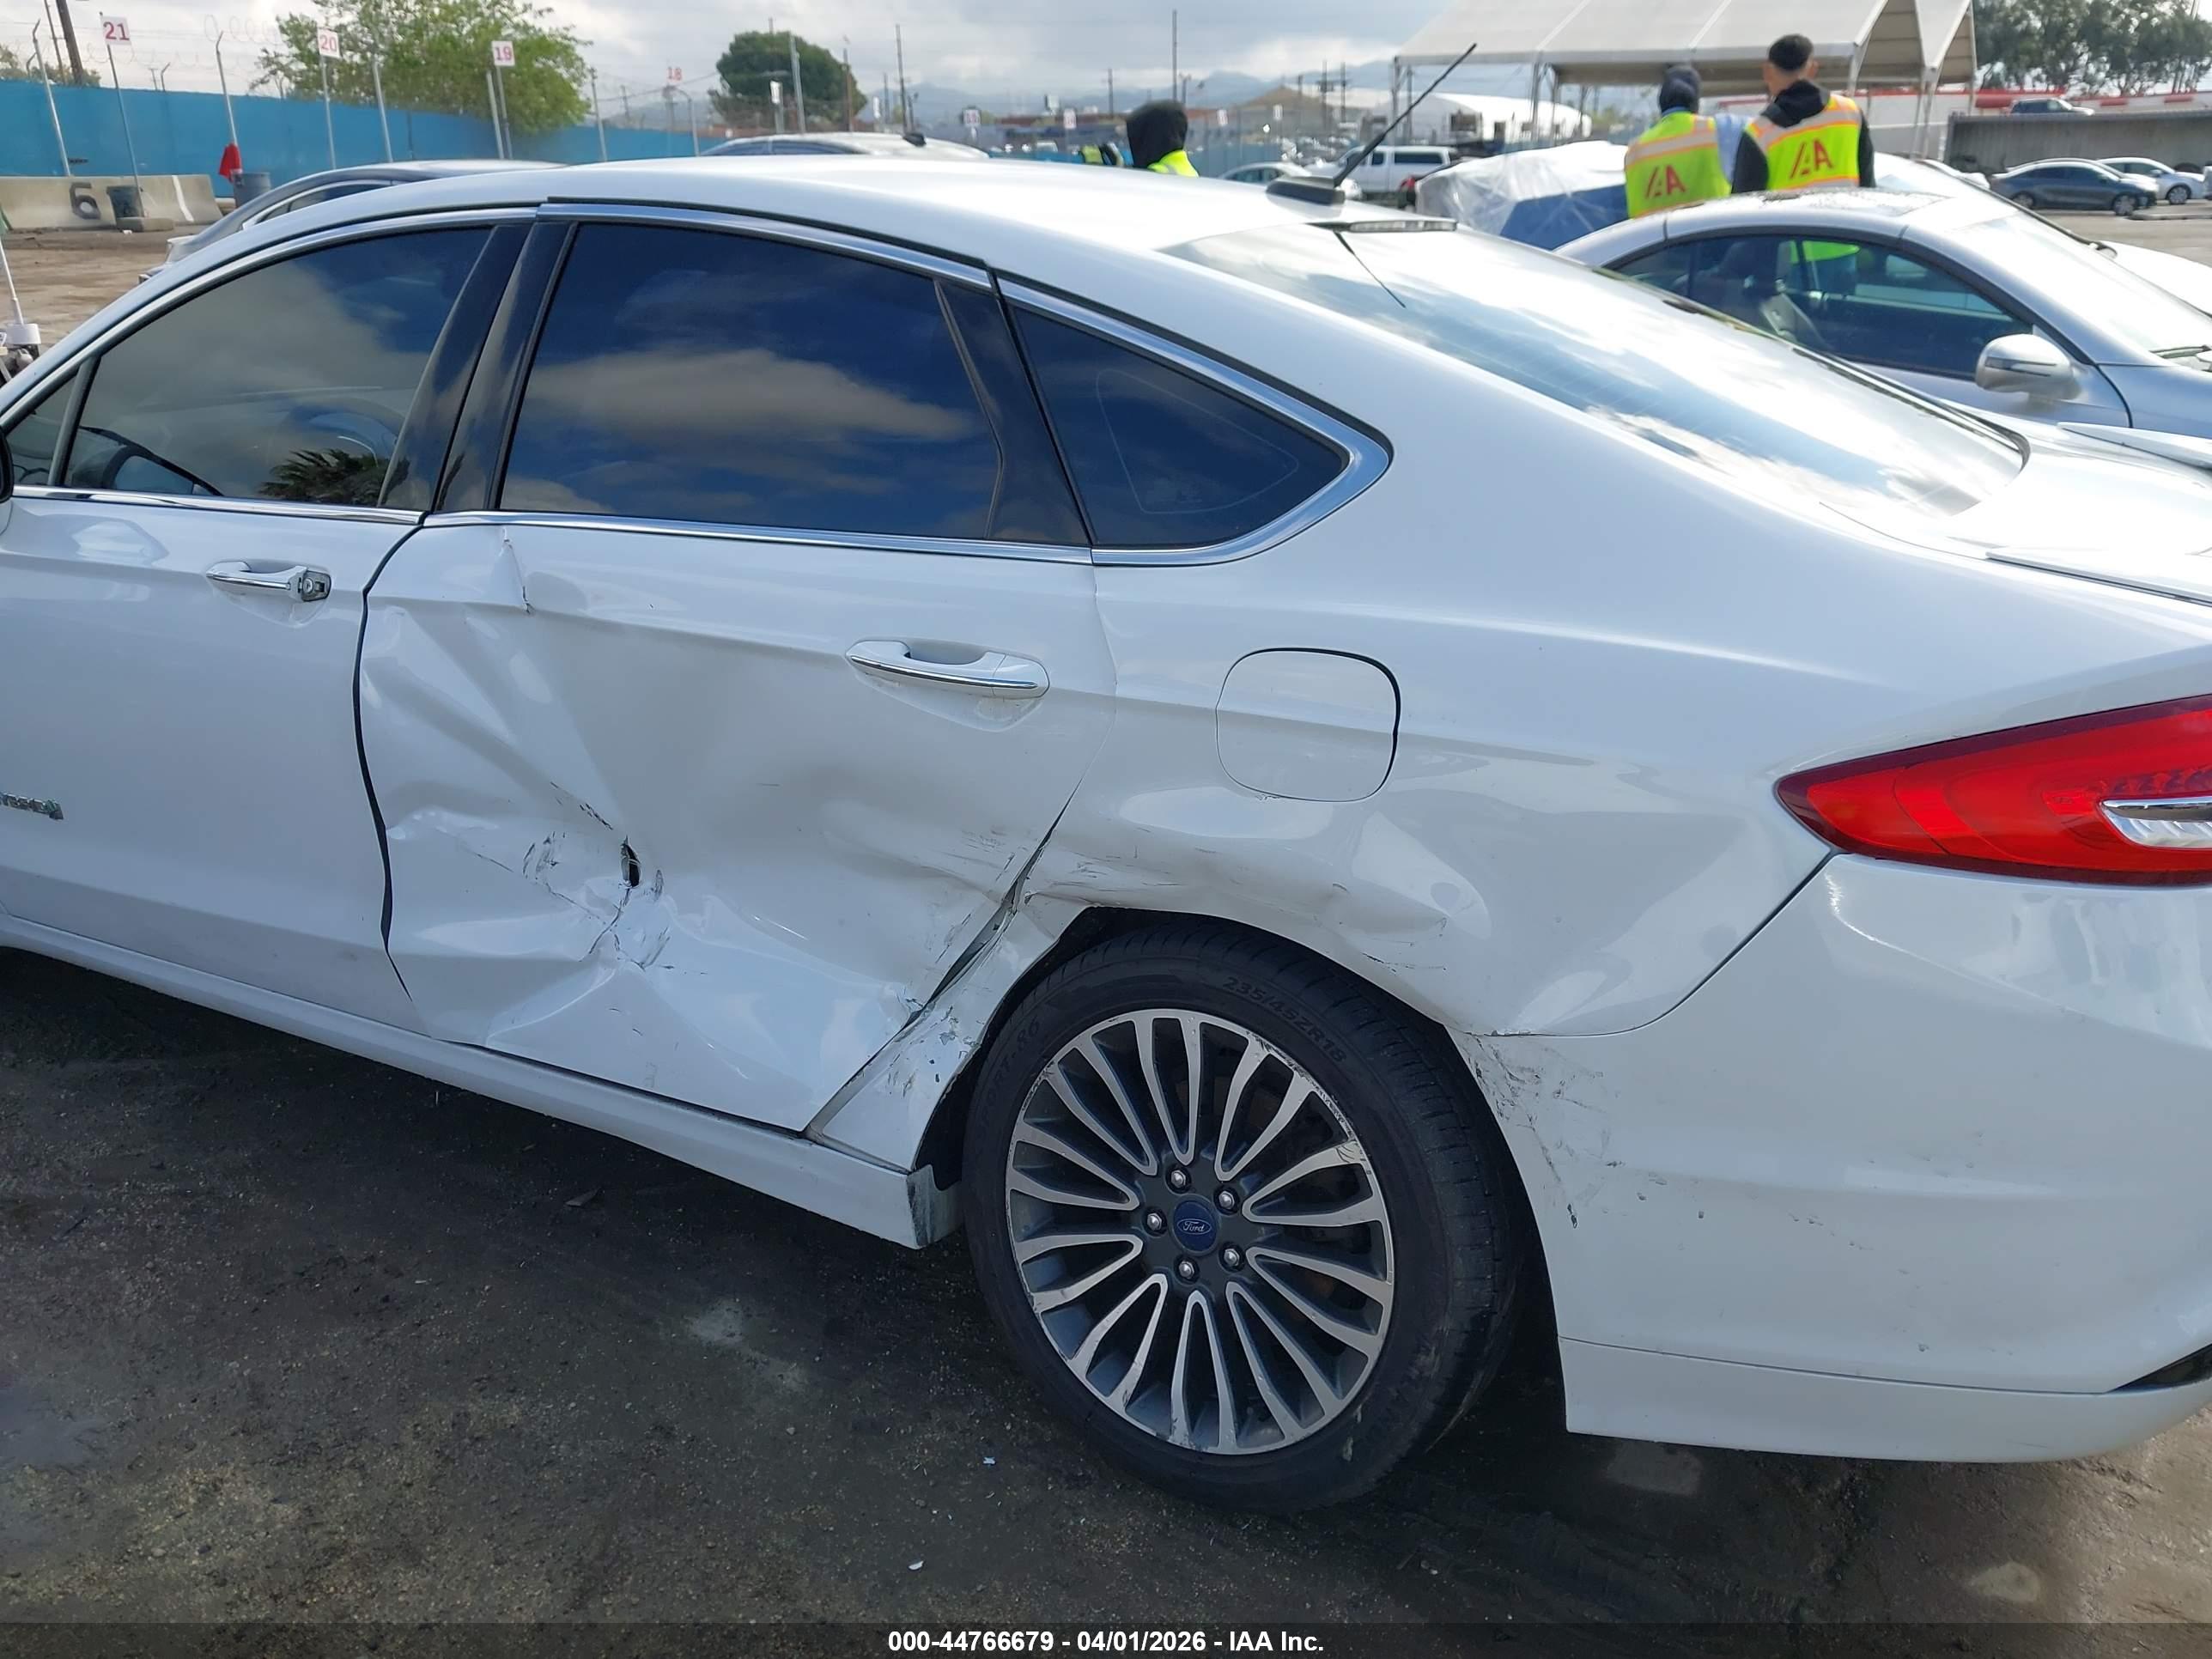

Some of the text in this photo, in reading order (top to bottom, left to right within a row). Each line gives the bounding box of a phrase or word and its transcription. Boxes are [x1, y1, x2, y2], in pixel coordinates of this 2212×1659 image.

[103, 21, 130, 40] 21
[319, 34, 337, 52] 20
[495, 46, 512, 60] 19
[70, 182, 101, 220] 6
[1222, 976, 1348, 1063] 235/45ZR18
[1182, 1220, 1205, 1232] Ford
